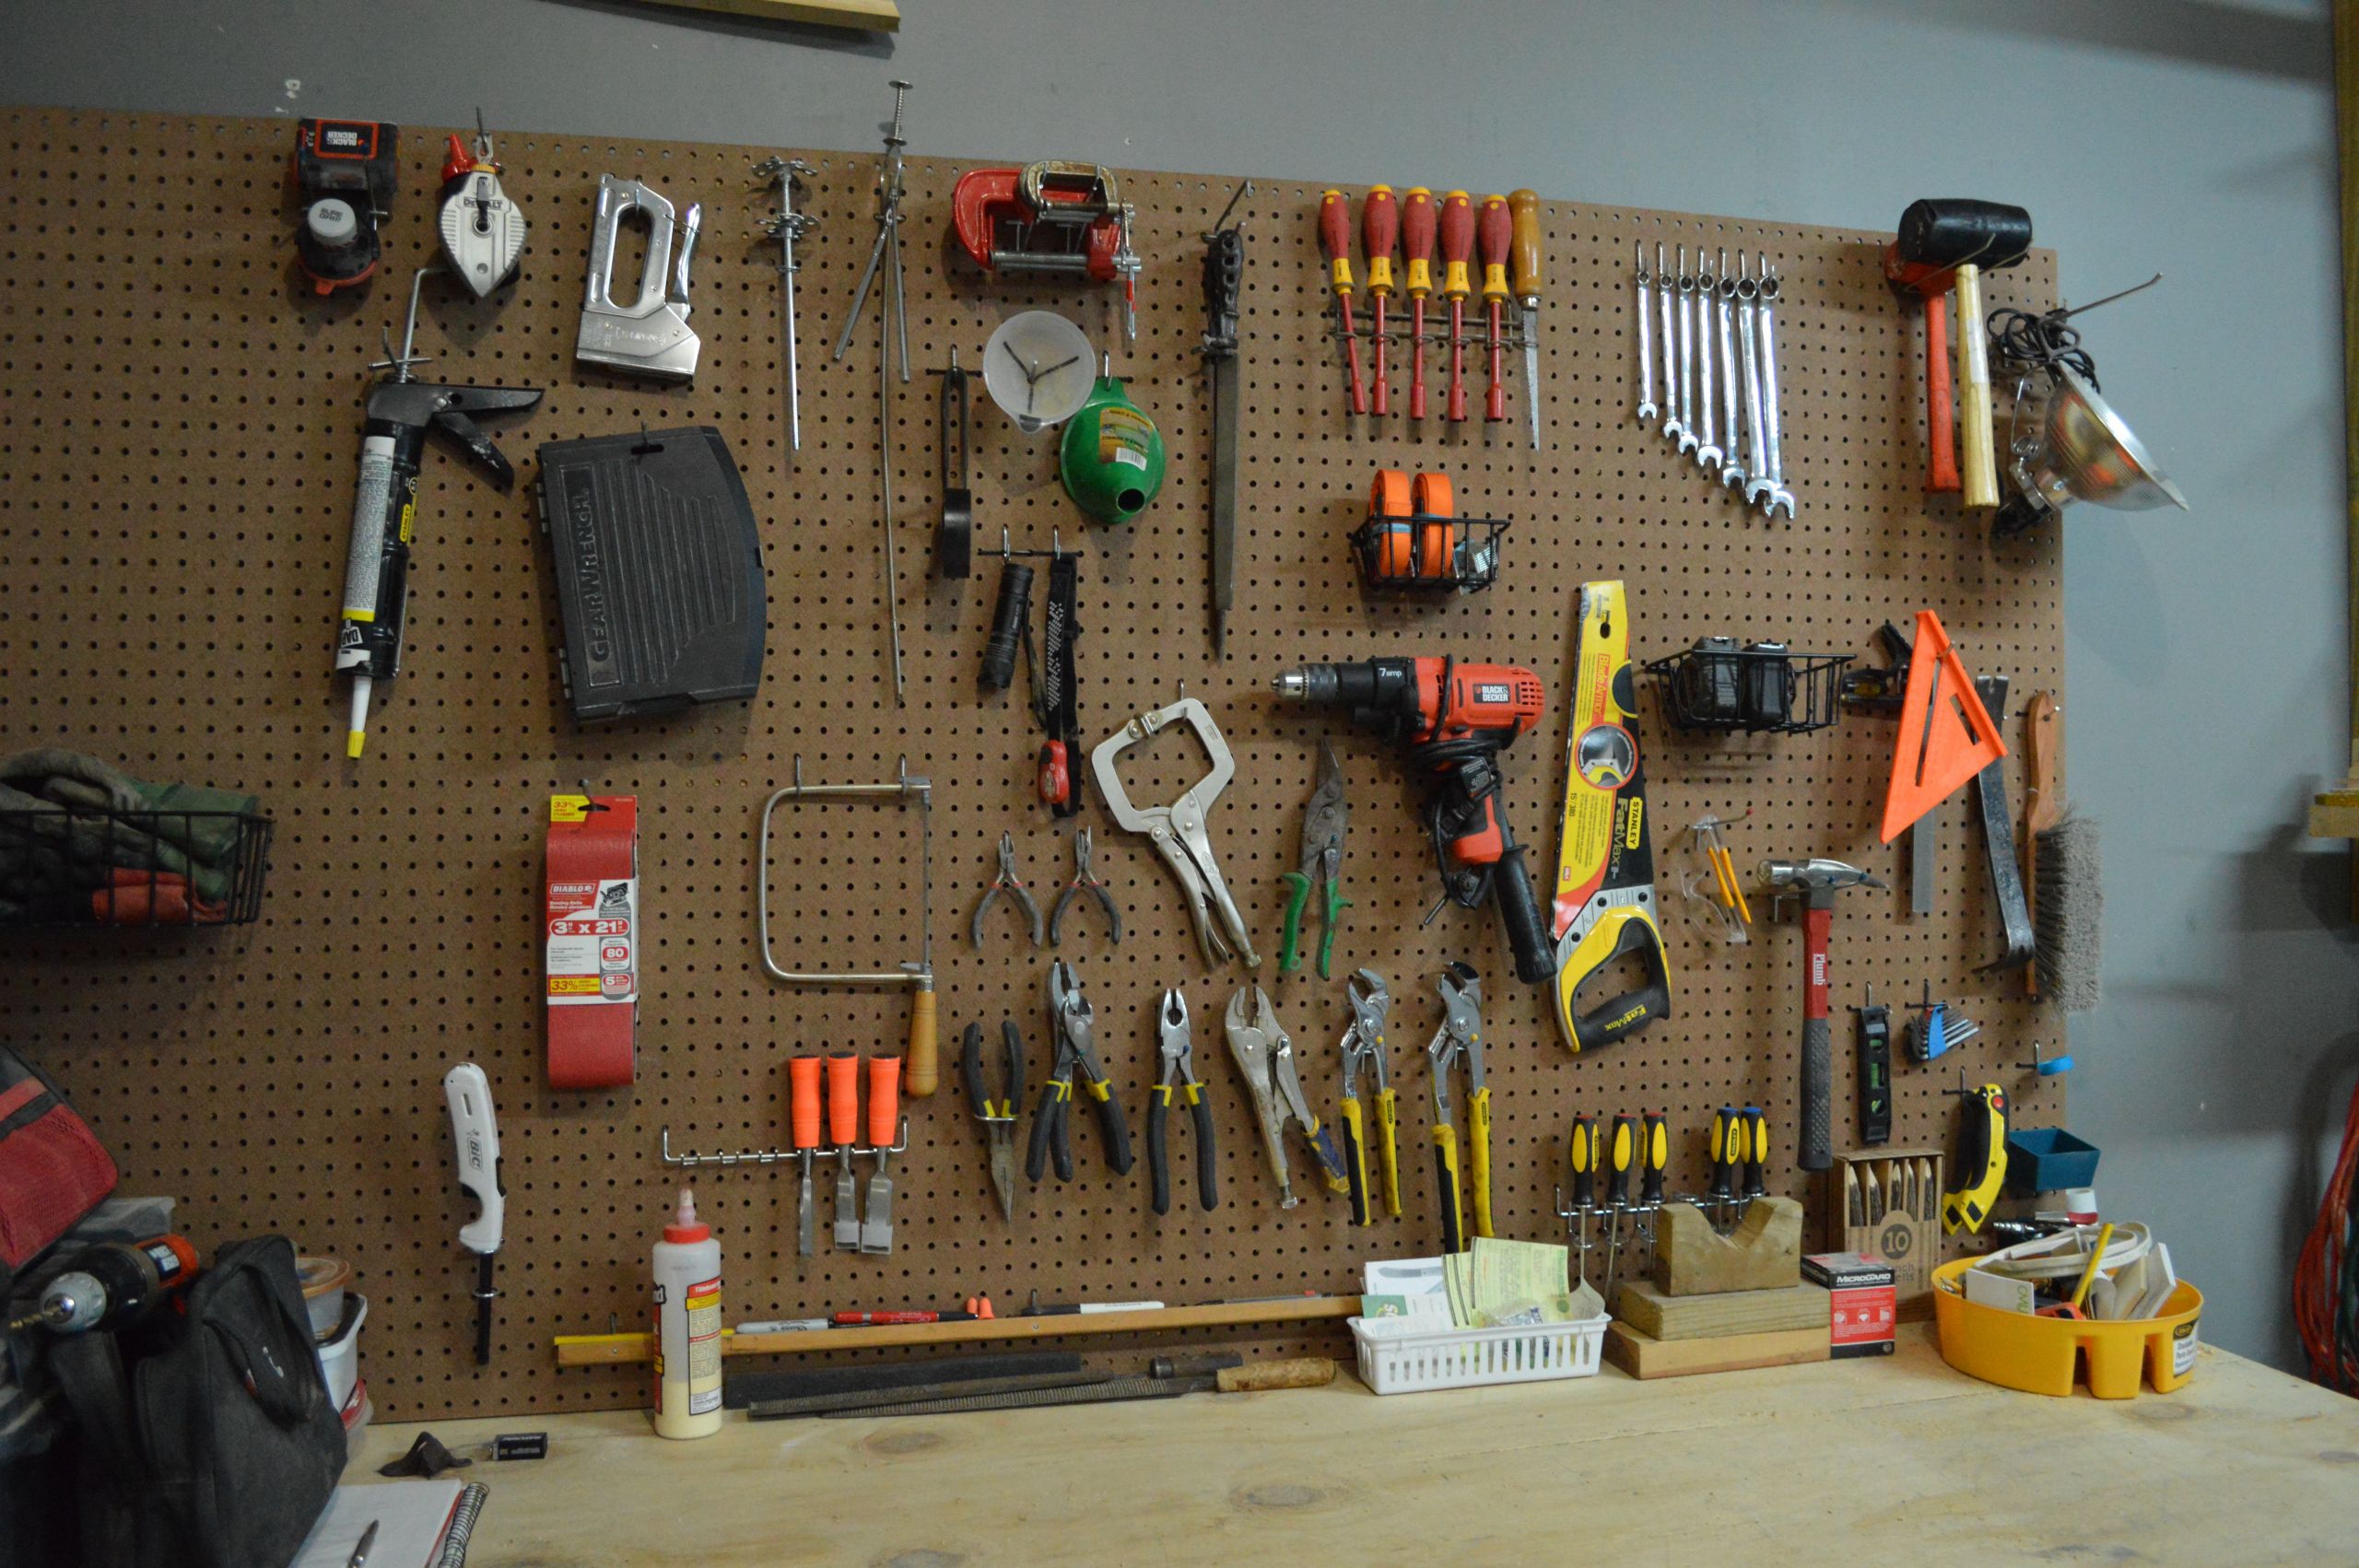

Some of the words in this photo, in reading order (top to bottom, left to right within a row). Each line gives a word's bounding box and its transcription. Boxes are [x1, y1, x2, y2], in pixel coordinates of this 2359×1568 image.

[400, 506, 411, 541] STANLEY
[572, 496, 610, 662] GEARWRENCH
[1483, 694, 1508, 702] DECKER
[1611, 797, 1628, 864] FatMax
[1629, 801, 1640, 846] STANLEY
[606, 948, 625, 958] 80
[604, 977, 616, 986] 5
[1813, 954, 1826, 986] Plumb
[551, 980, 579, 990] 33%
[1604, 1006, 1648, 1031] FatMax
[1885, 1231, 1909, 1253] 10
